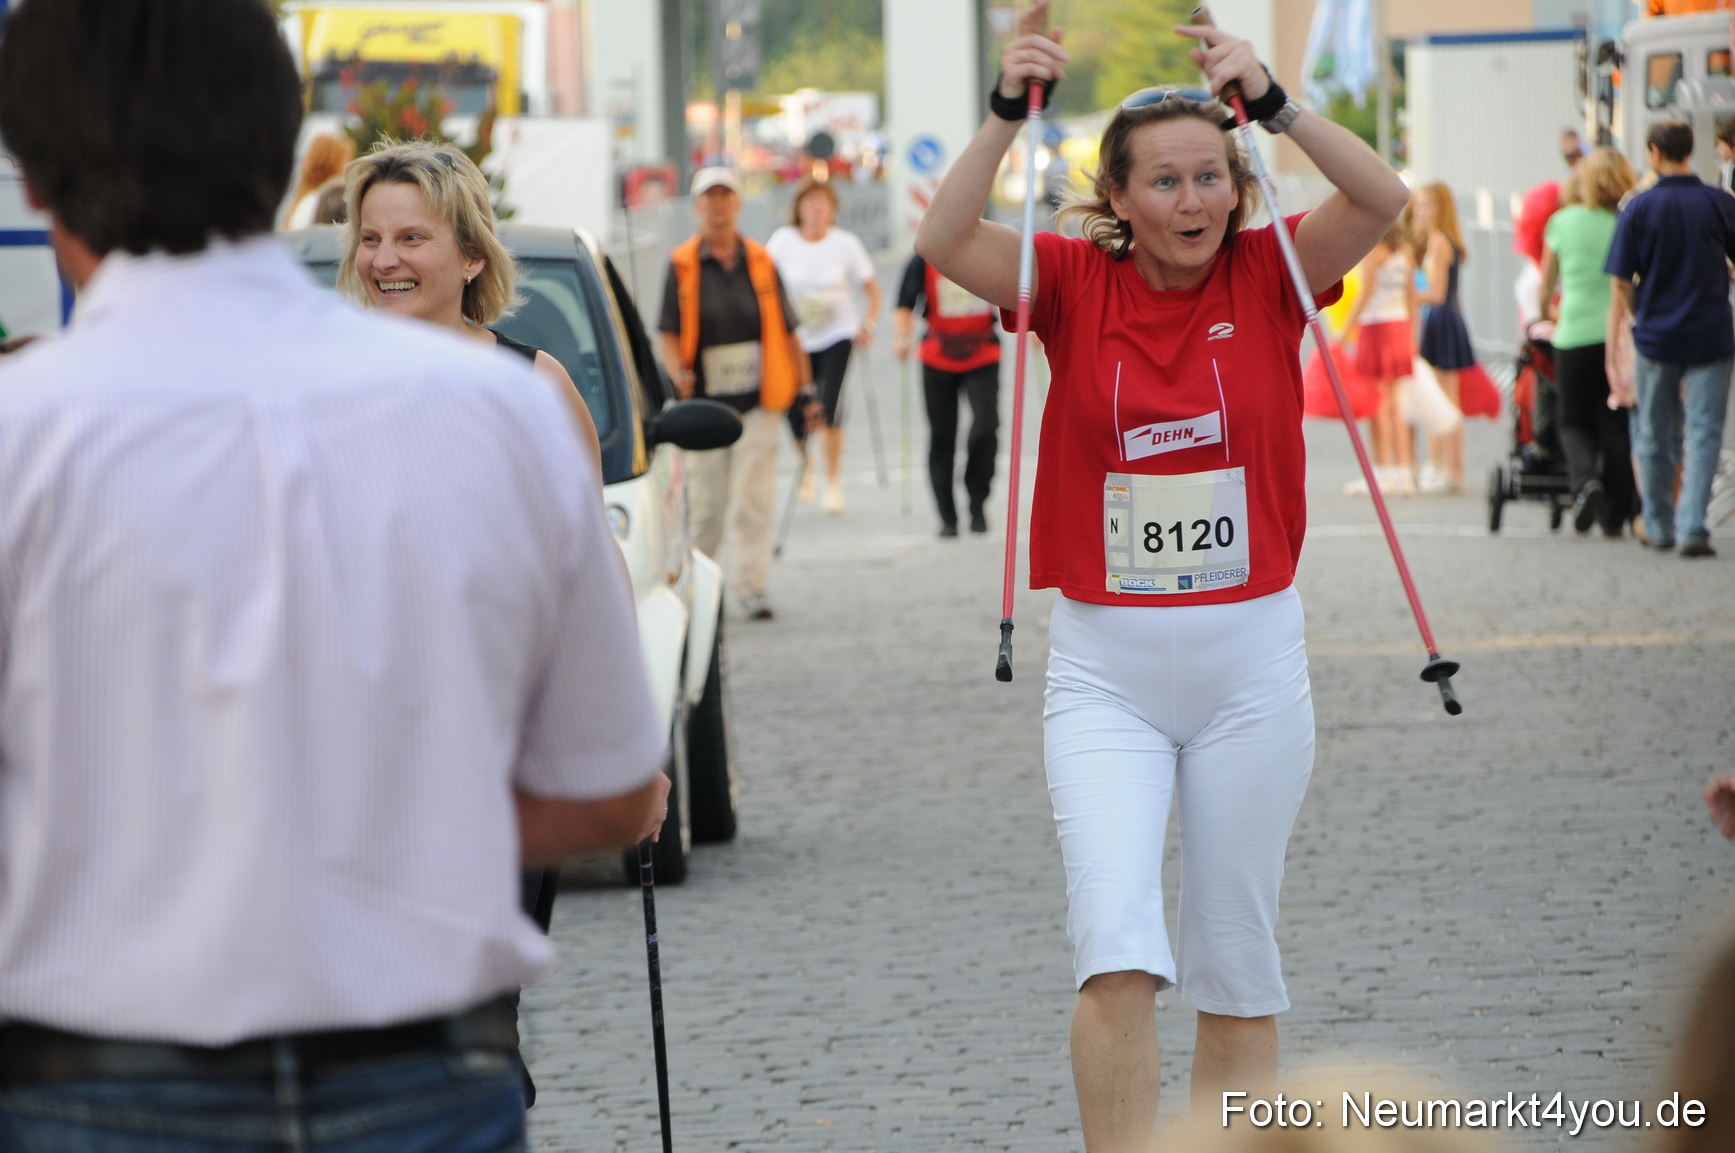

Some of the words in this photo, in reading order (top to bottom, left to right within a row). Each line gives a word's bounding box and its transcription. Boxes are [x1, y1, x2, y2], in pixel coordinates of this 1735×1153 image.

[1152, 427, 1194, 446] DEHN
[1110, 517, 1119, 534] N
[1143, 516, 1234, 554] 8120
[1119, 578, 1156, 588] BOCK
[1194, 567, 1247, 584] PFLEIDERER
